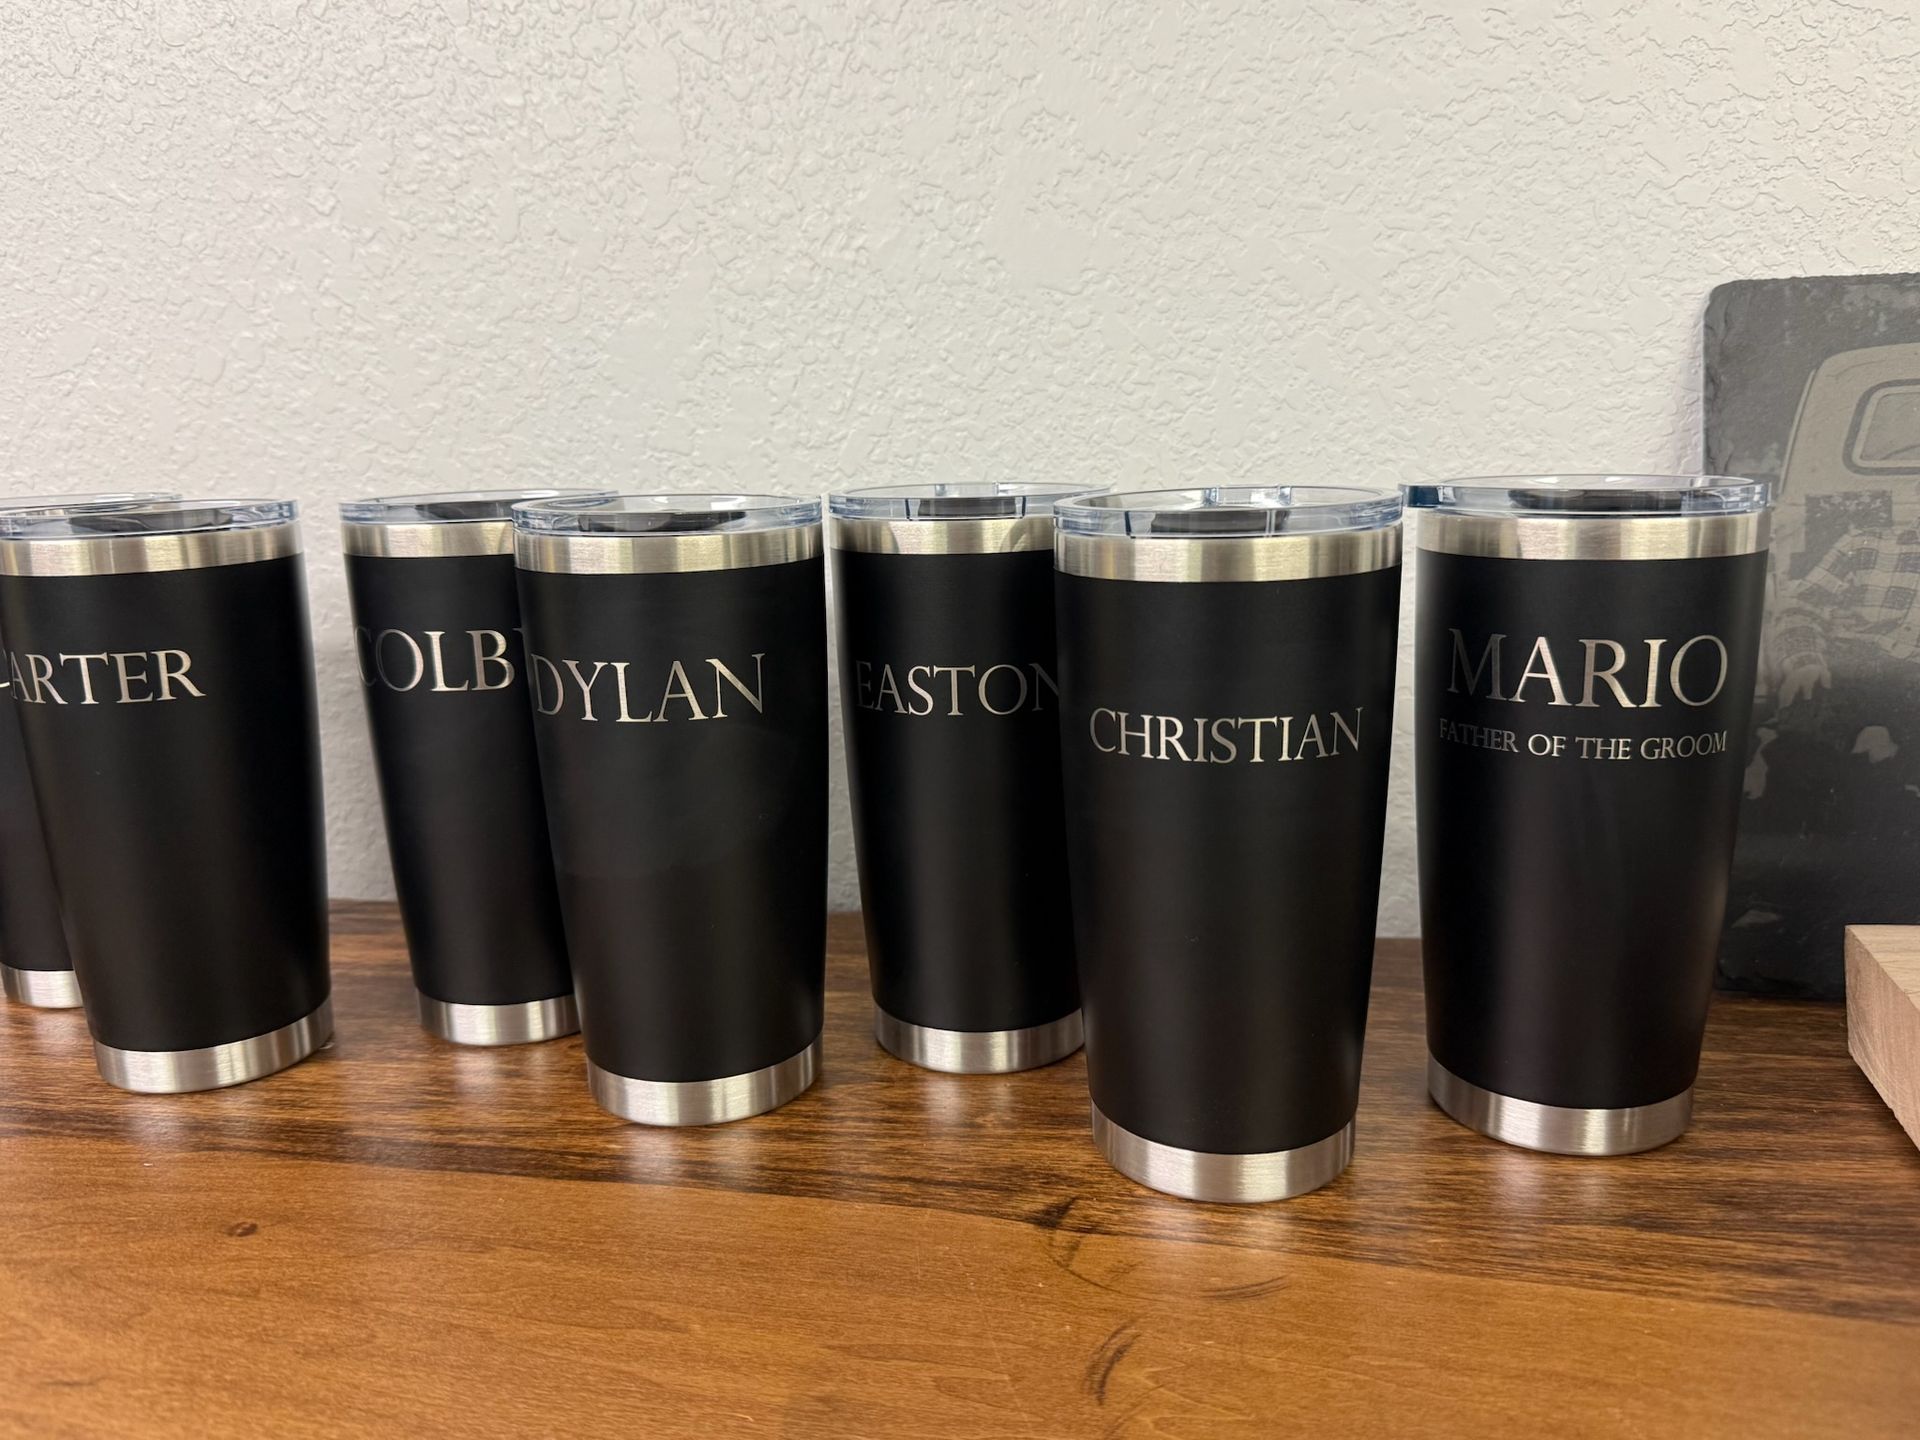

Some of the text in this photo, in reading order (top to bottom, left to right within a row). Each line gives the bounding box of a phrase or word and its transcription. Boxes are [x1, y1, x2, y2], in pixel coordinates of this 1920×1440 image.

[5, 649, 207, 705] ARTER
[531, 653, 765, 723] DYLAN
[855, 660, 1060, 716] EASTON
[1447, 628, 1728, 708] MARIO
[1089, 707, 1364, 764] CHRISTIAN
[1439, 718, 1728, 760] FATHER OF THE GROOM
